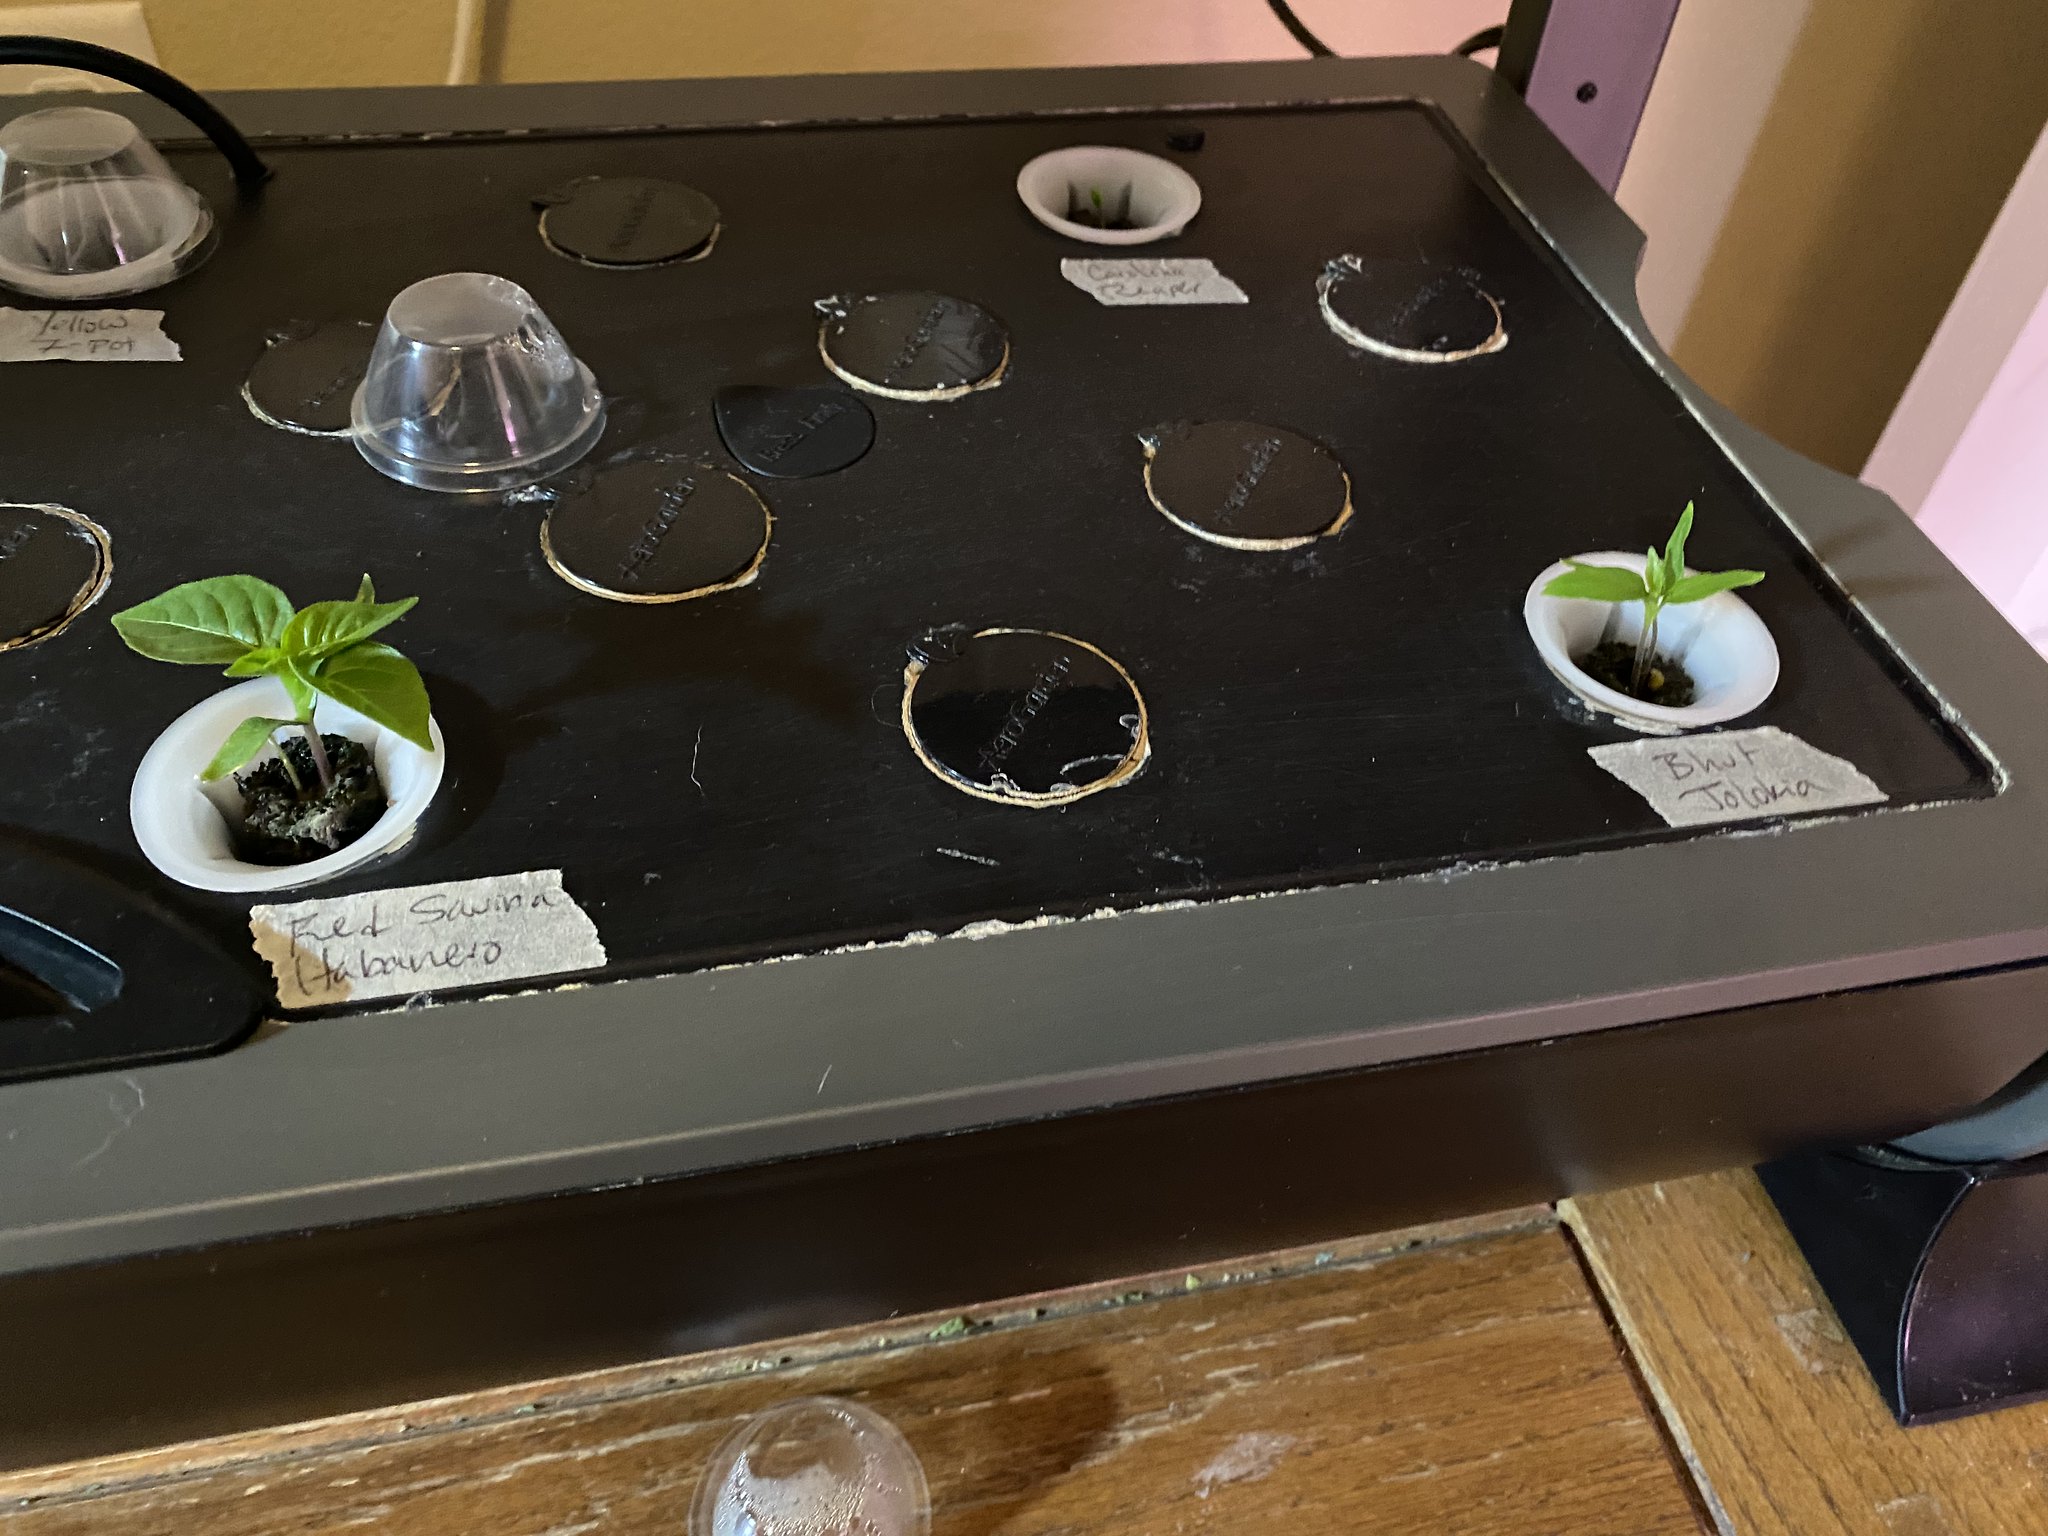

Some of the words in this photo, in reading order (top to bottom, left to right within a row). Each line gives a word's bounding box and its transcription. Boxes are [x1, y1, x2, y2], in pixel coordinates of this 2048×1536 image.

[32, 311, 130, 335] Yellow
[1652, 741, 1760, 780] Bhut
[287, 905, 392, 957] Red
[410, 890, 559, 926] Savina
[294, 940, 502, 996] Habanero
